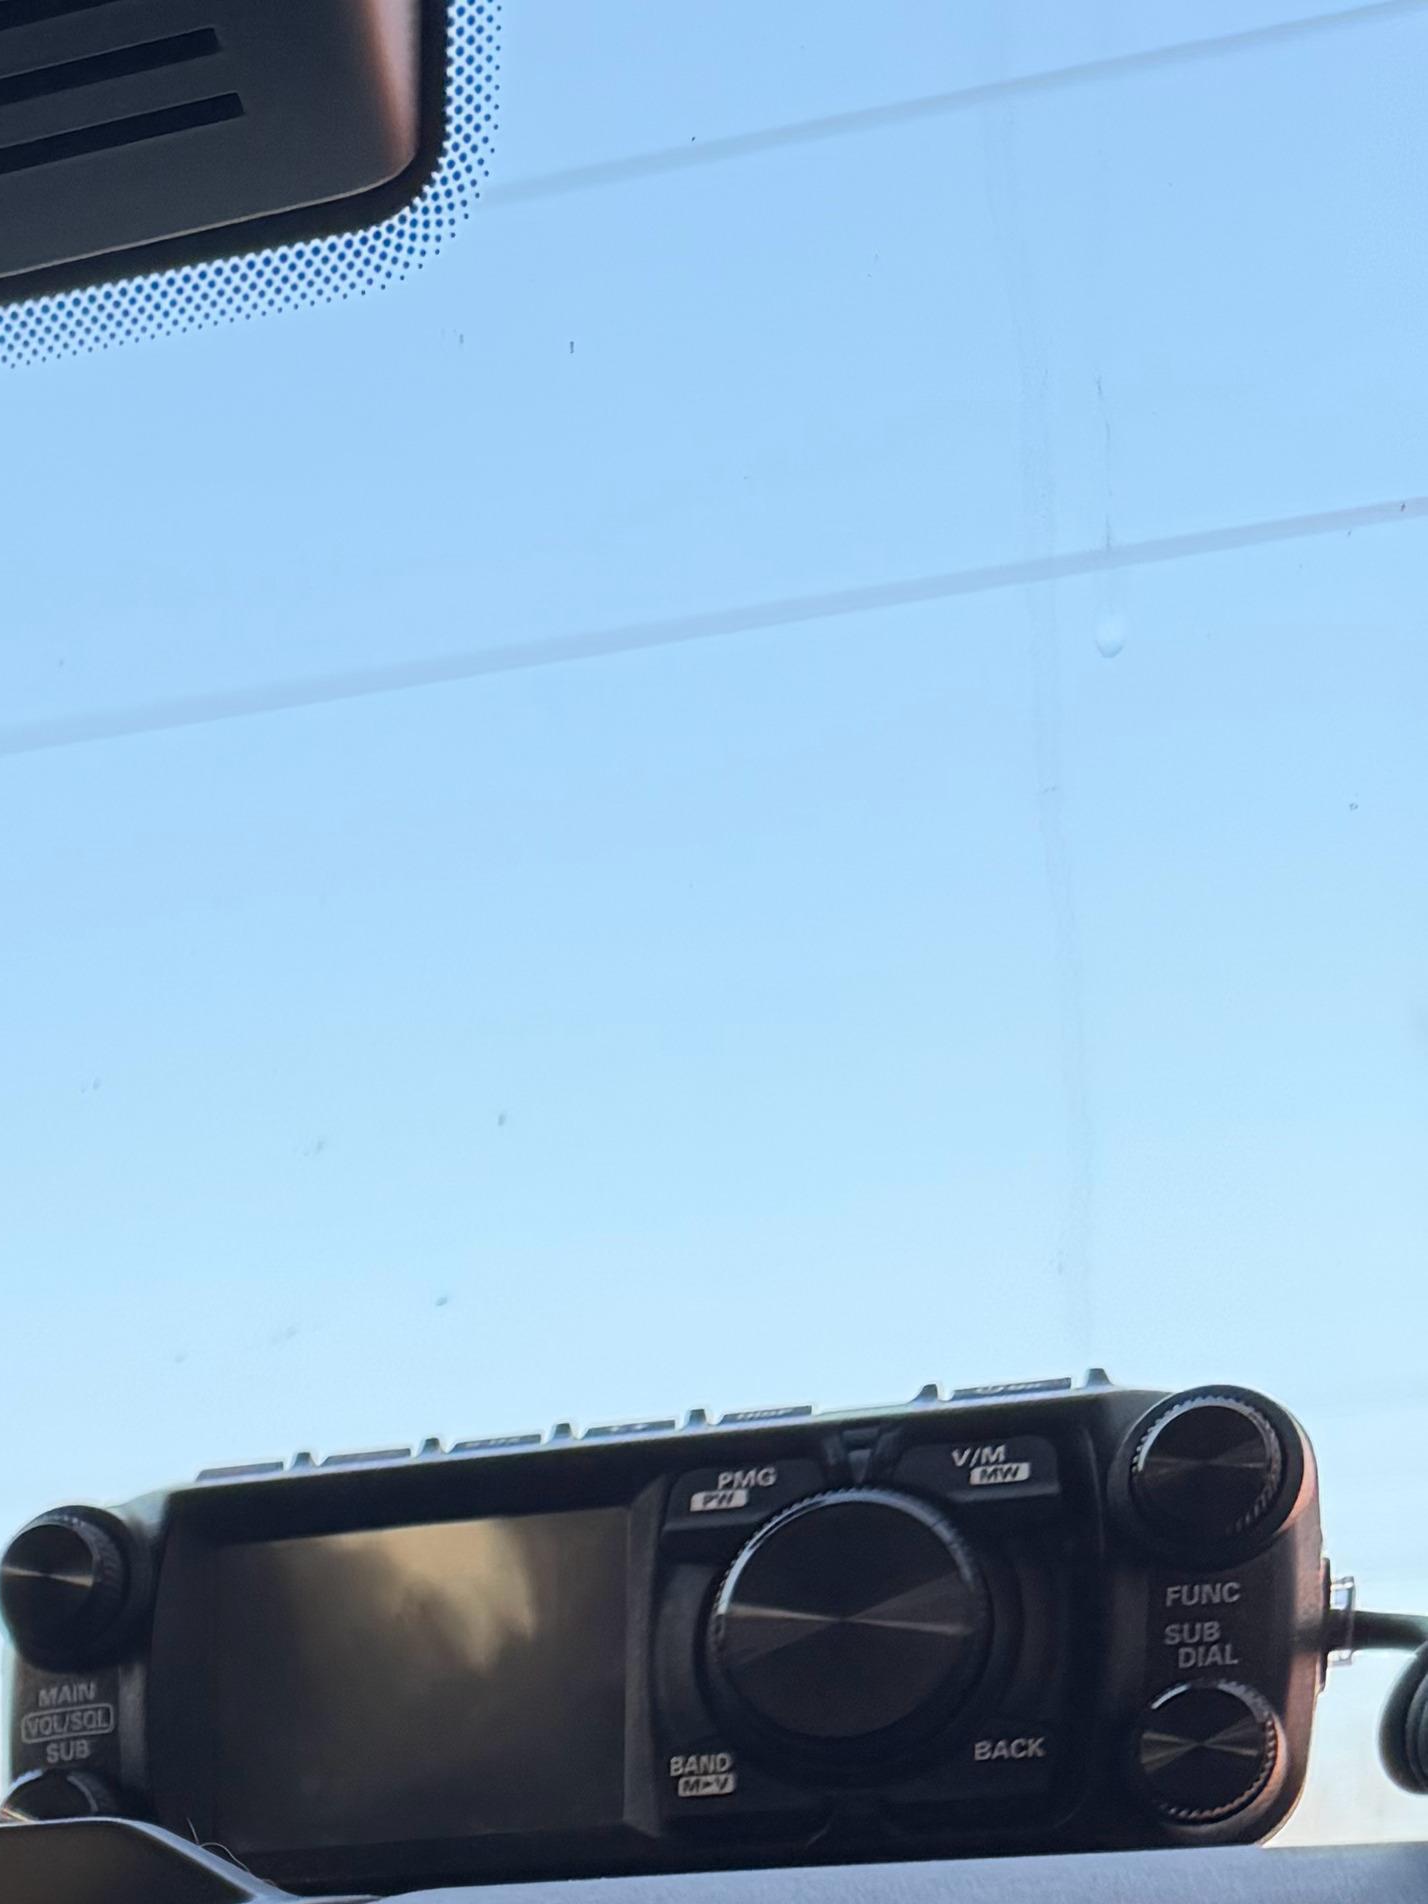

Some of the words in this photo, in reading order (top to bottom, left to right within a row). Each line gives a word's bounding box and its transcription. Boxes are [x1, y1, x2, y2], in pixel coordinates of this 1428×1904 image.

[951, 1445, 1007, 1467] V/M
[717, 1467, 777, 1490] PMG
[979, 1465, 1021, 1483] MW
[1166, 1582, 1241, 1607] FUNC
[1164, 1621, 1221, 1645] SUB
[1178, 1644, 1239, 1669] DIAL
[38, 1682, 96, 1707] MAIN
[25, 1708, 109, 1737] VOL/SQL
[46, 1739, 92, 1763] SUB
[974, 1737, 1045, 1761] BACK
[670, 1752, 734, 1776] BAND
